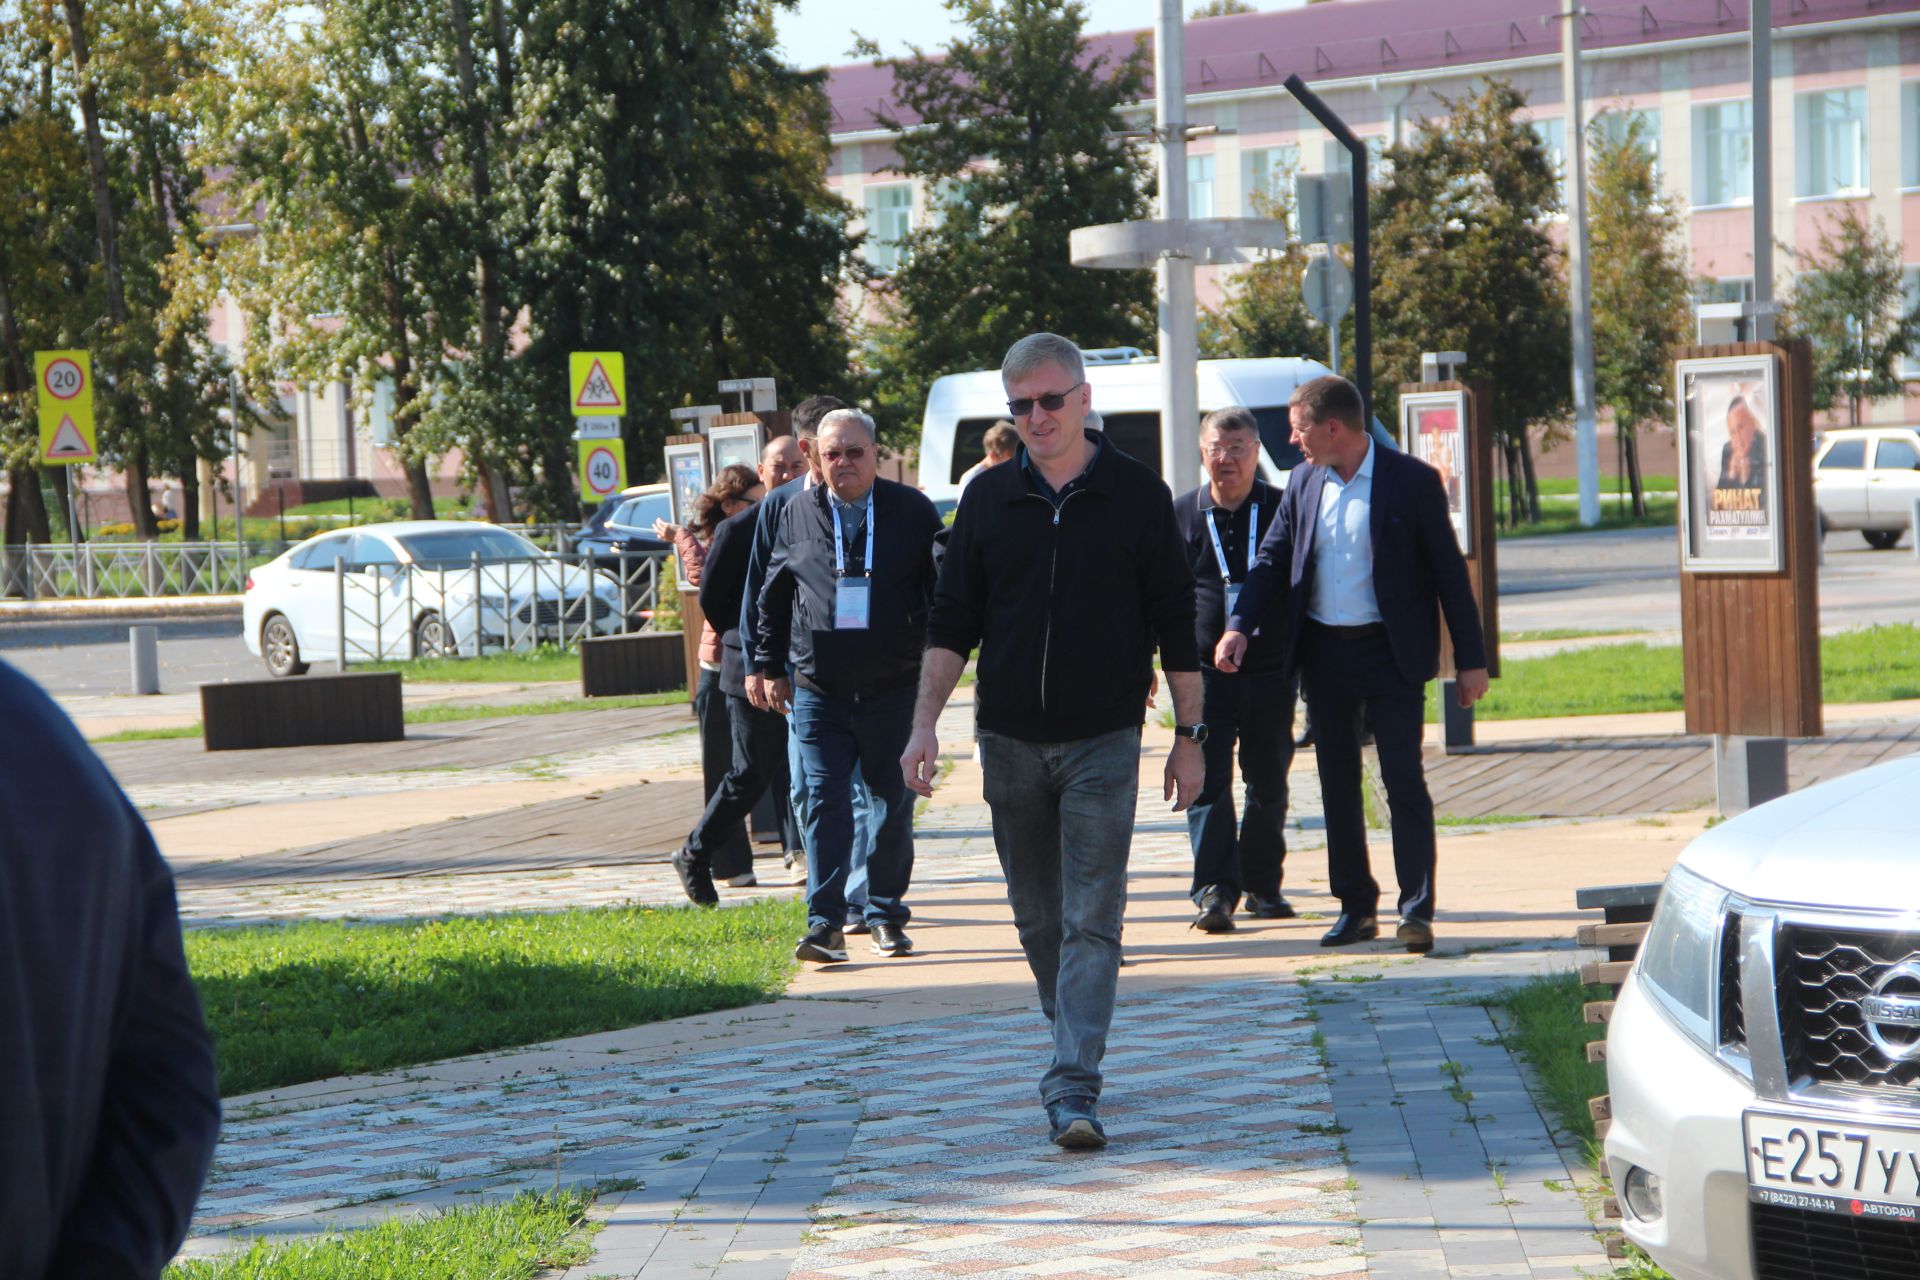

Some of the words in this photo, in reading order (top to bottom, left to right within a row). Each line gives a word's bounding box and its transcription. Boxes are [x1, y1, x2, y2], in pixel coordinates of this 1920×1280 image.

[53, 370, 75, 388] 20
[593, 462, 611, 480] 40
[1712, 488, 1761, 511] РИНАТ
[1759, 1191, 1769, 1201] +7
[1770, 1192, 1797, 1206] (8422)
[1798, 1196, 1836, 1211] 27-14-14
[1863, 1203, 1916, 1218] АВТОРАЙ
